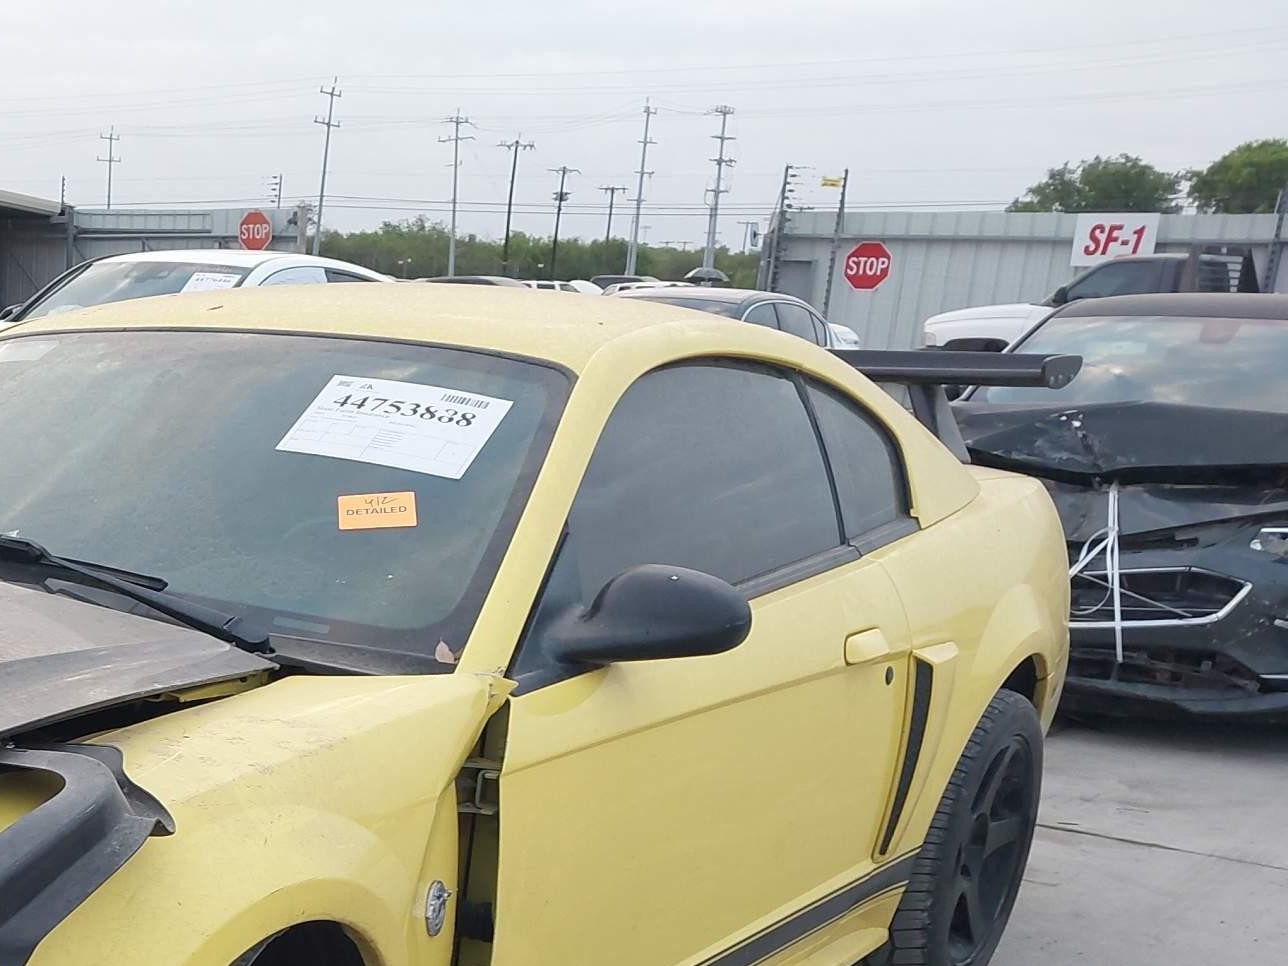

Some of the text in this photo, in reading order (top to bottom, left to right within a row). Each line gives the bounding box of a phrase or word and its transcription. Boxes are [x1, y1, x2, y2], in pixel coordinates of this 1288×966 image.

[241, 223, 269, 239] STOP
[1084, 223, 1146, 256] SF-1
[847, 257, 889, 275] STOP
[346, 506, 407, 516] DETAILED
